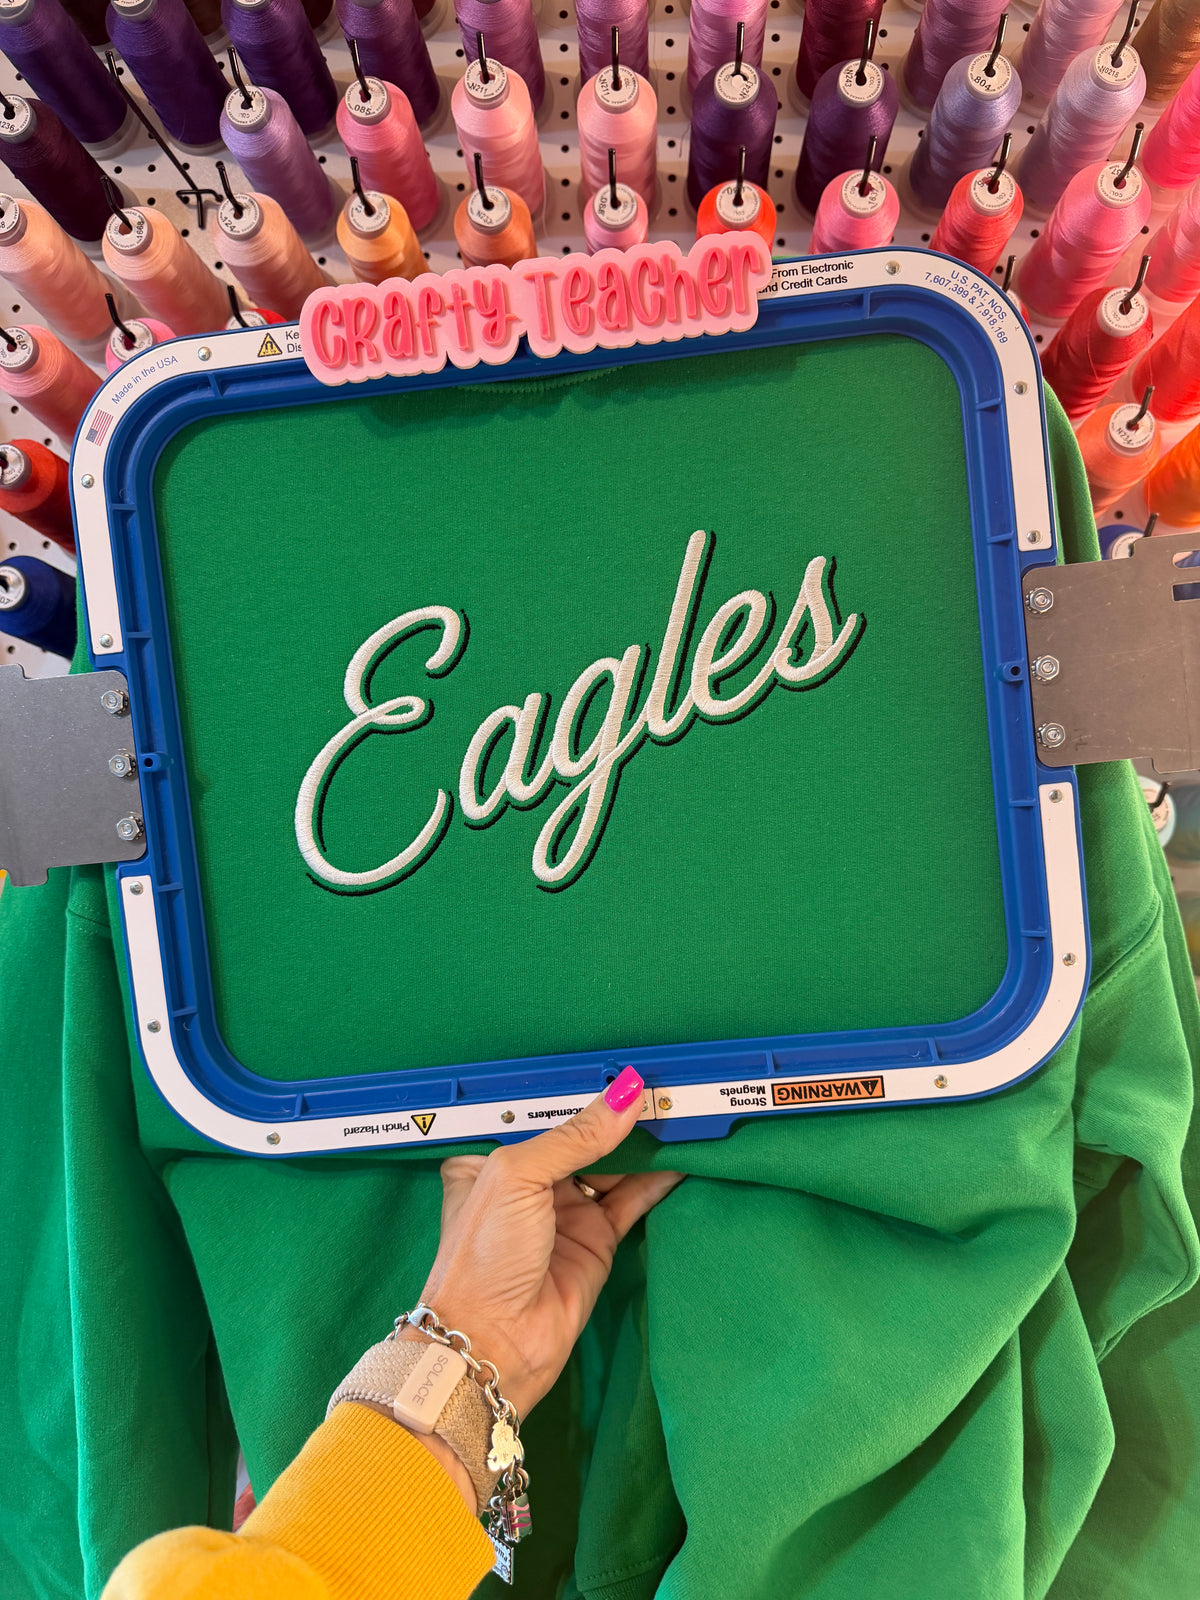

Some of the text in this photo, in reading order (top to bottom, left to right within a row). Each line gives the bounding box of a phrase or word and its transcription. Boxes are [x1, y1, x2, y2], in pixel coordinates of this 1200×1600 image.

[845, 69, 854, 88] N243
[973, 76, 991, 91] 804
[470, 83, 488, 95] N211
[601, 79, 610, 94] N211
[354, 104, 372, 116] 085
[0, 119, 15, 132] 236
[1111, 168, 1130, 179] 137
[136, 221, 144, 239] 1668
[222, 216, 236, 231] 124
[771, 260, 854, 279] From Electronic
[781, 278, 813, 291] Credit
[816, 274, 848, 286] Cards
[951, 270, 1007, 323] U.S. PAT. NOS.
[968, 295, 977, 305] &
[111, 355, 178, 405] Made in the USA
[294, 530, 866, 896] Eagles
[720, 1084, 766, 1097] Magnets
[777, 1082, 861, 1102] WARNING
[730, 1097, 767, 1107] Strong
[343, 1122, 410, 1137] Pinch Hazard
[412, 1354, 449, 1406] SOLACE
